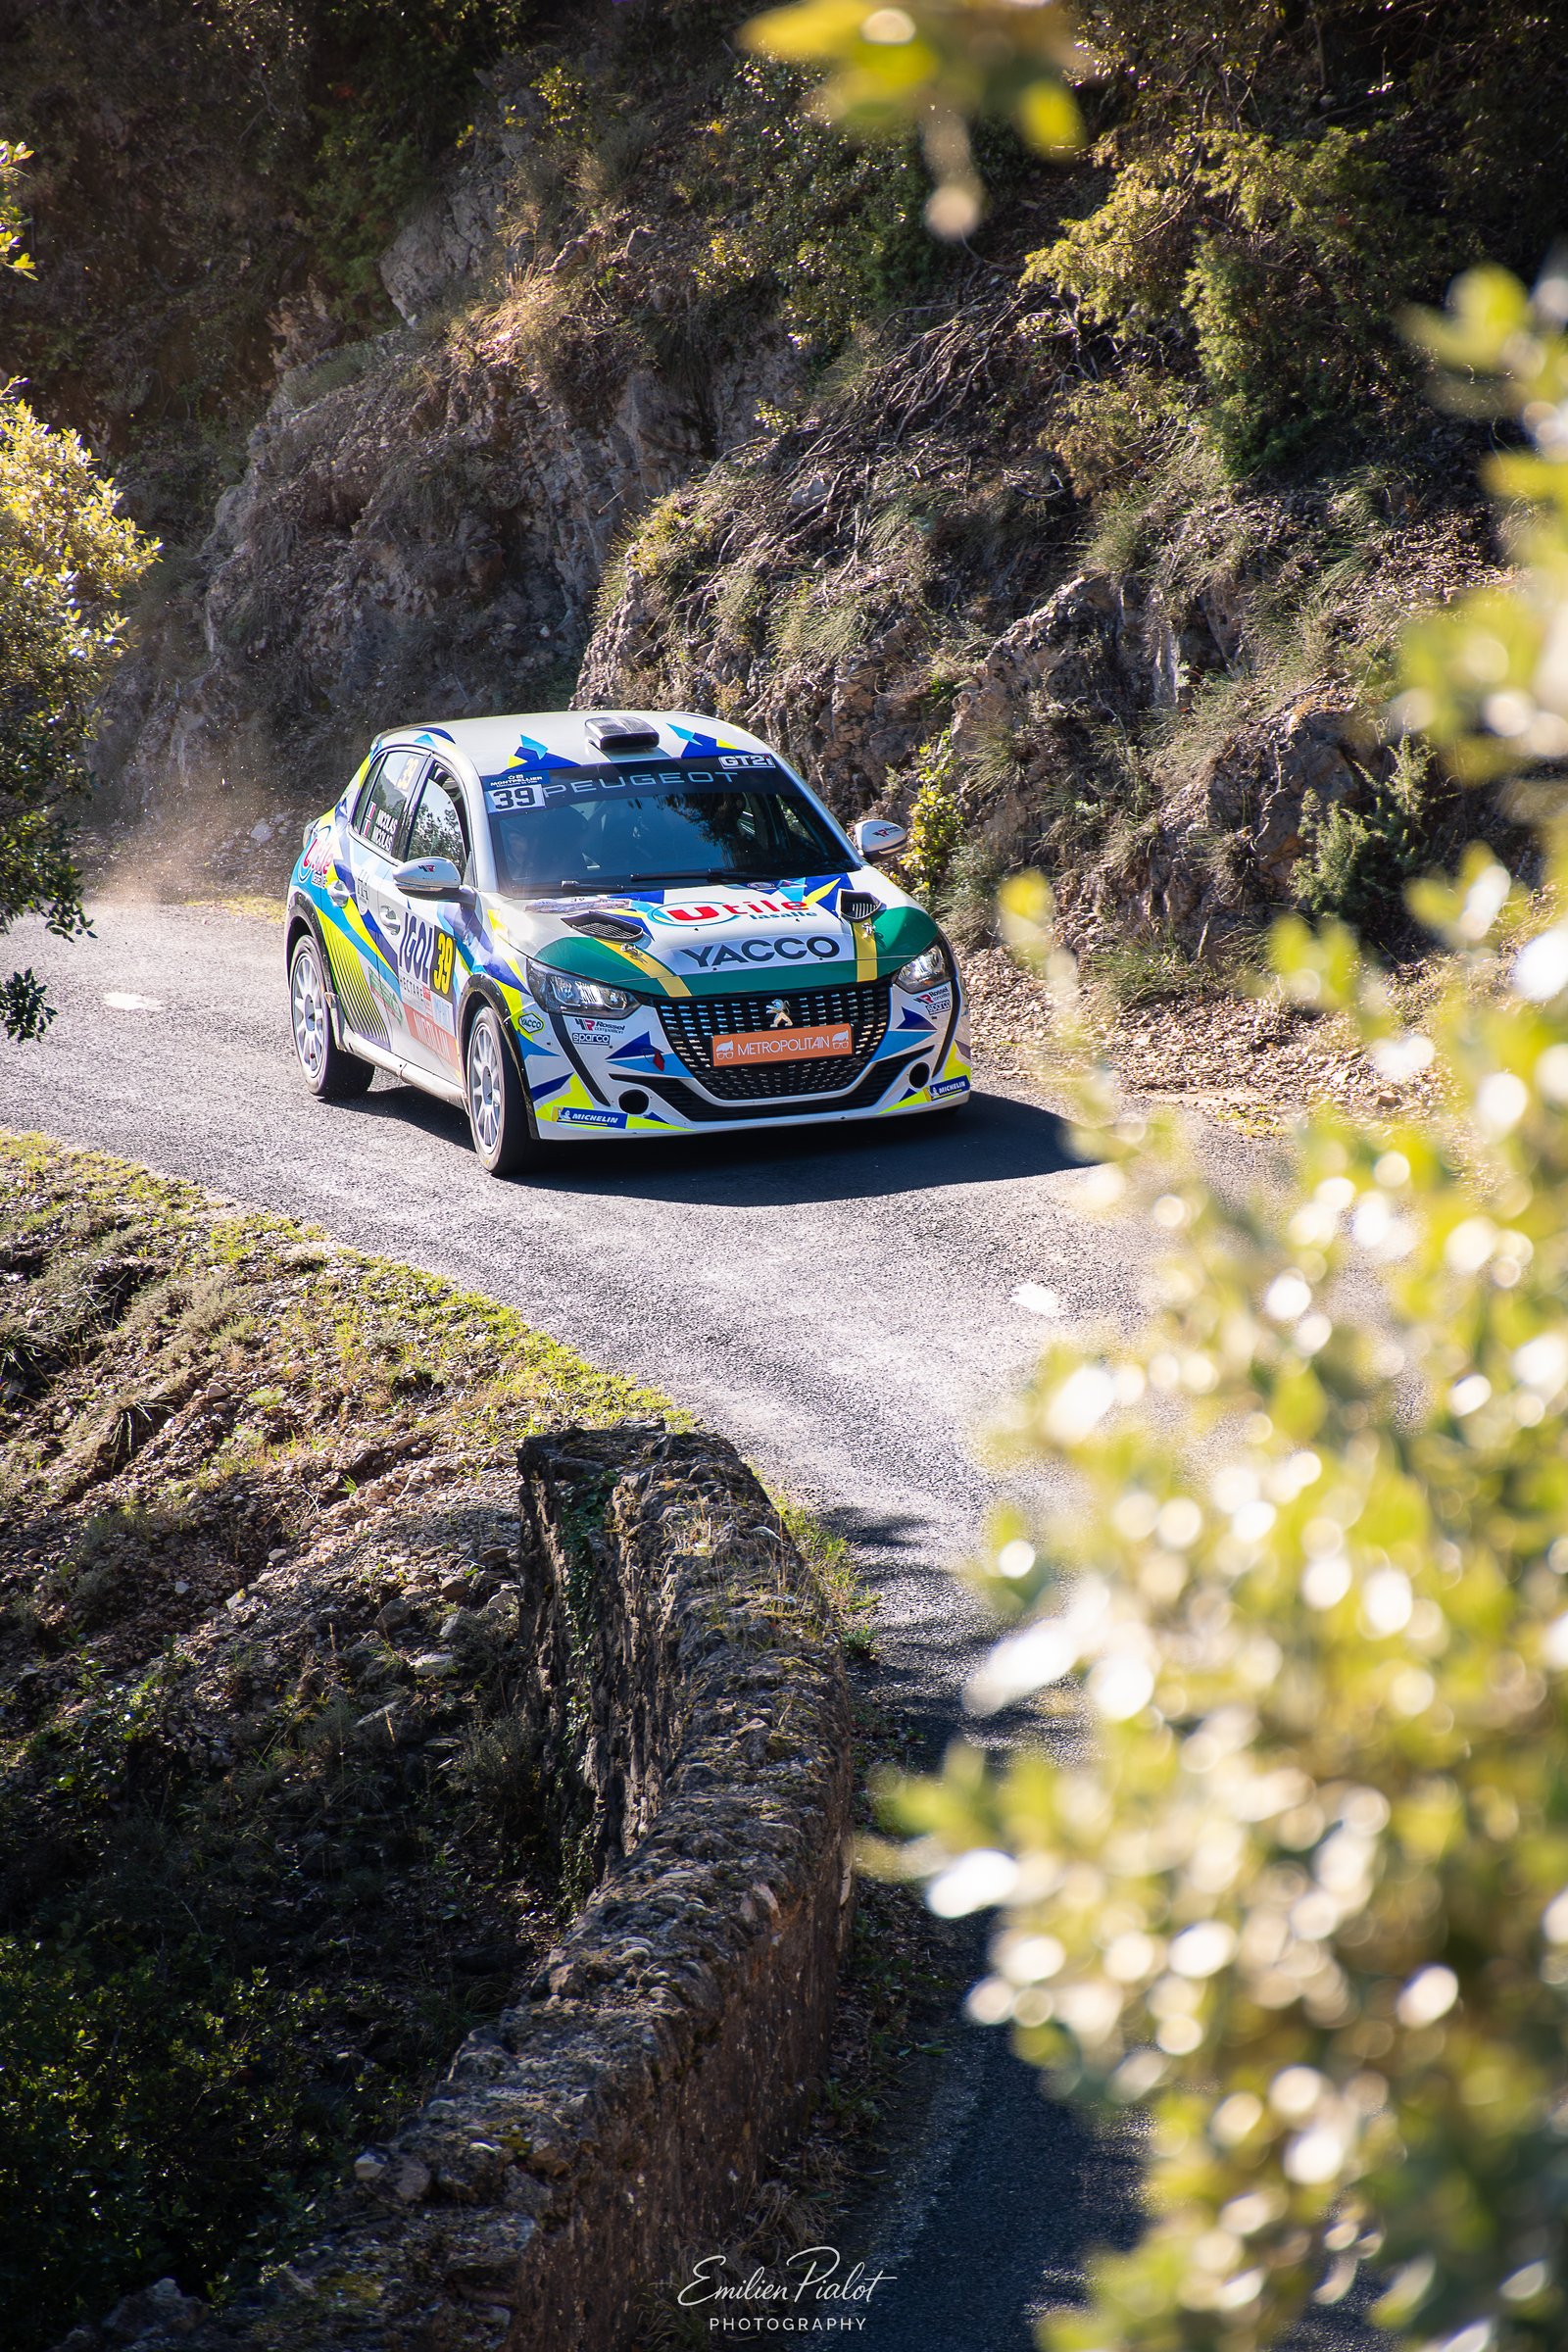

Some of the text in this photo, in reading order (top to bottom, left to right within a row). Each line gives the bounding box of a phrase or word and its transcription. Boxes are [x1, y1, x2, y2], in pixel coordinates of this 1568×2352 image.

[722, 754, 773, 766] GT2i
[543, 771, 738, 798] PEUGEOT
[493, 787, 535, 809] 39
[666, 900, 809, 921] Utile
[750, 910, 817, 920] lasalle
[399, 912, 433, 985] IGOL
[680, 936, 841, 968] YACCO
[433, 932, 454, 995] 39
[520, 1017, 542, 1029] YACCO
[596, 1021, 625, 1031] Rossel
[572, 1033, 610, 1045] sparco
[737, 1036, 830, 1056] METROPOLITAIN
[939, 1080, 966, 1094] MICHELIN
[572, 1113, 618, 1124] MICHELIN
